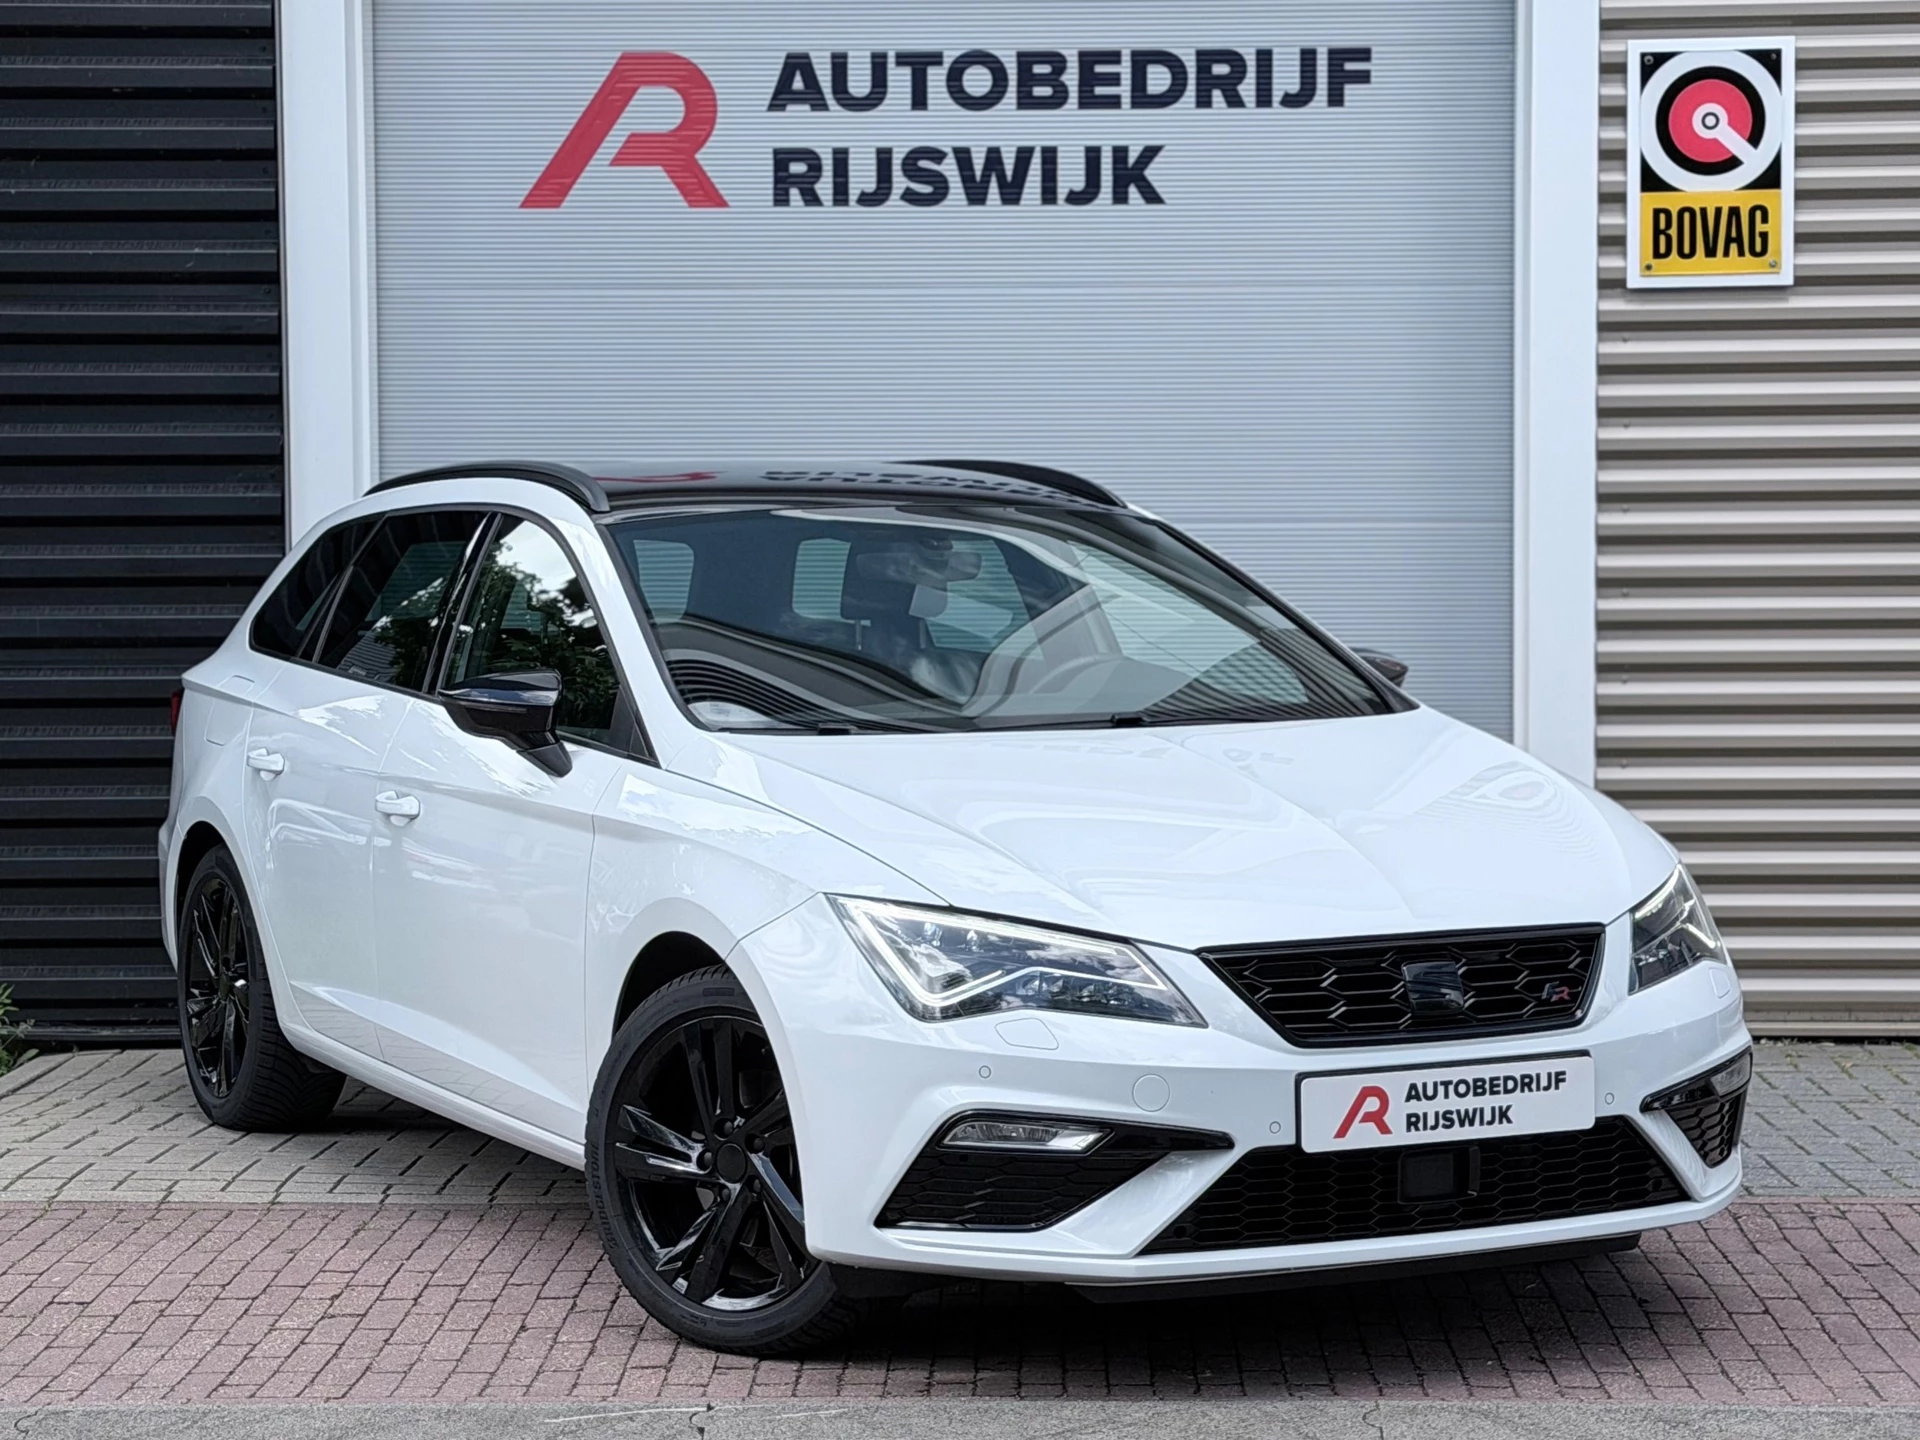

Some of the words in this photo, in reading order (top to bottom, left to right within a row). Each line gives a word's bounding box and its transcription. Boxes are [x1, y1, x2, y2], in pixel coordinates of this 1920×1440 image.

[767, 48, 1372, 112] AUTOBEDRIJF
[772, 145, 1166, 207] RIJSWIJK
[1652, 204, 1769, 260] BOVAG
[1404, 1070, 1567, 1103] AUTOBEDRIJF
[1405, 1104, 1513, 1133] RIJSWIJK
